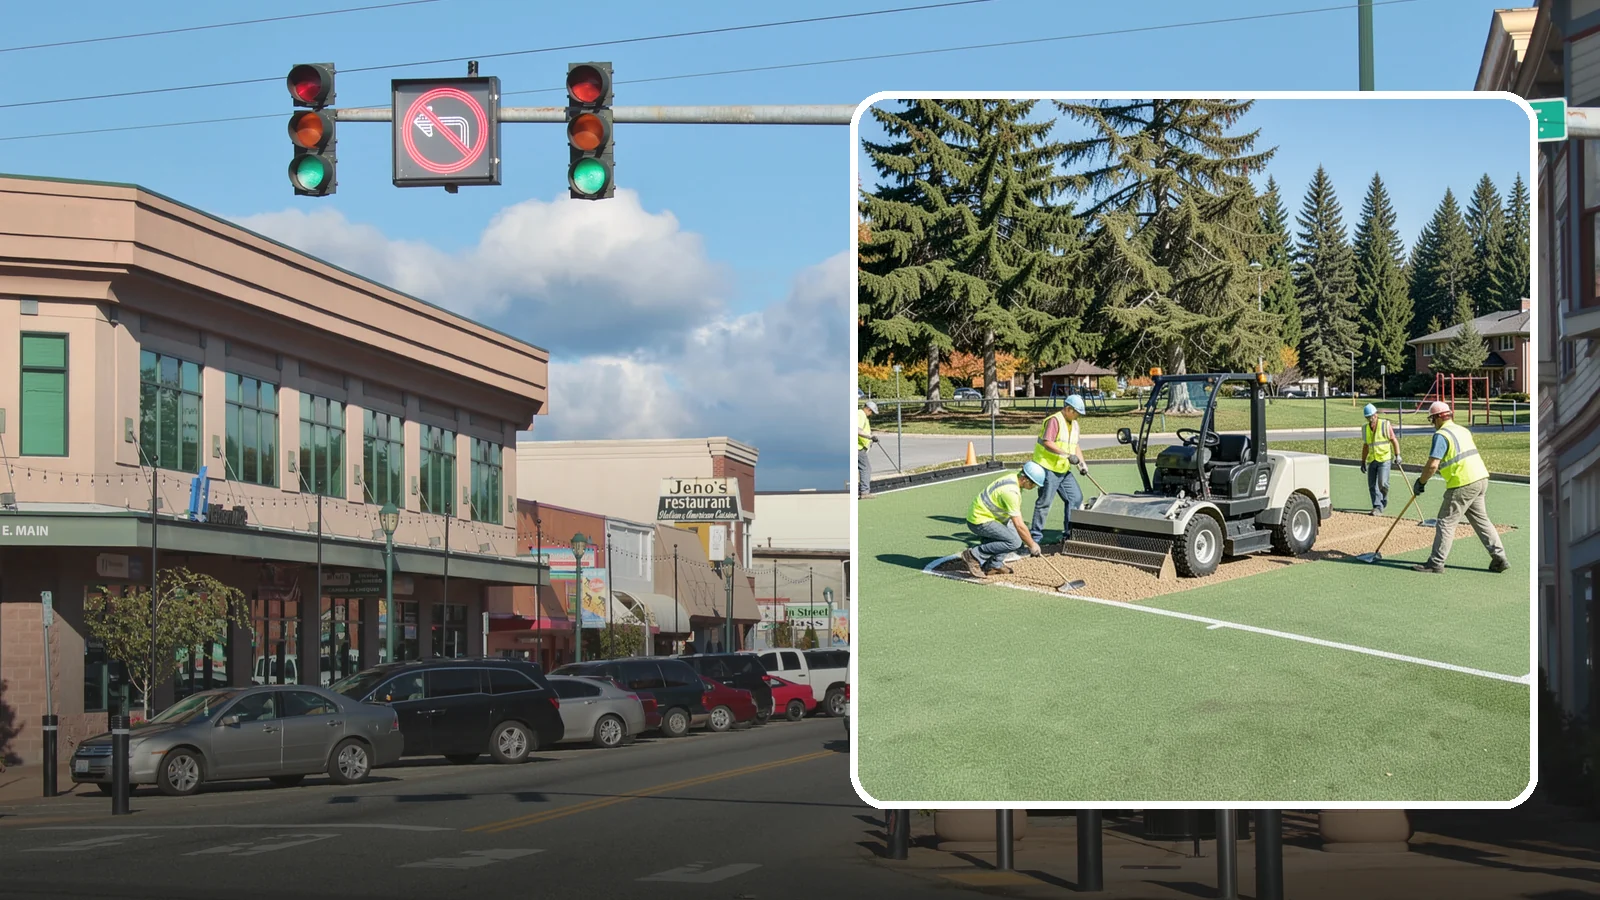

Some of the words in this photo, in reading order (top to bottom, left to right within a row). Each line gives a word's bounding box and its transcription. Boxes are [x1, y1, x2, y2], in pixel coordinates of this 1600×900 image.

[669, 480, 727, 494] Jeno's
[665, 496, 731, 509] restaurant
[659, 510, 681, 519] Italian
[686, 510, 714, 518] American
[715, 510, 737, 518] Cuisine
[2, 526, 13, 536] E.
[16, 526, 49, 536] MAIN
[798, 608, 828, 616] Street
